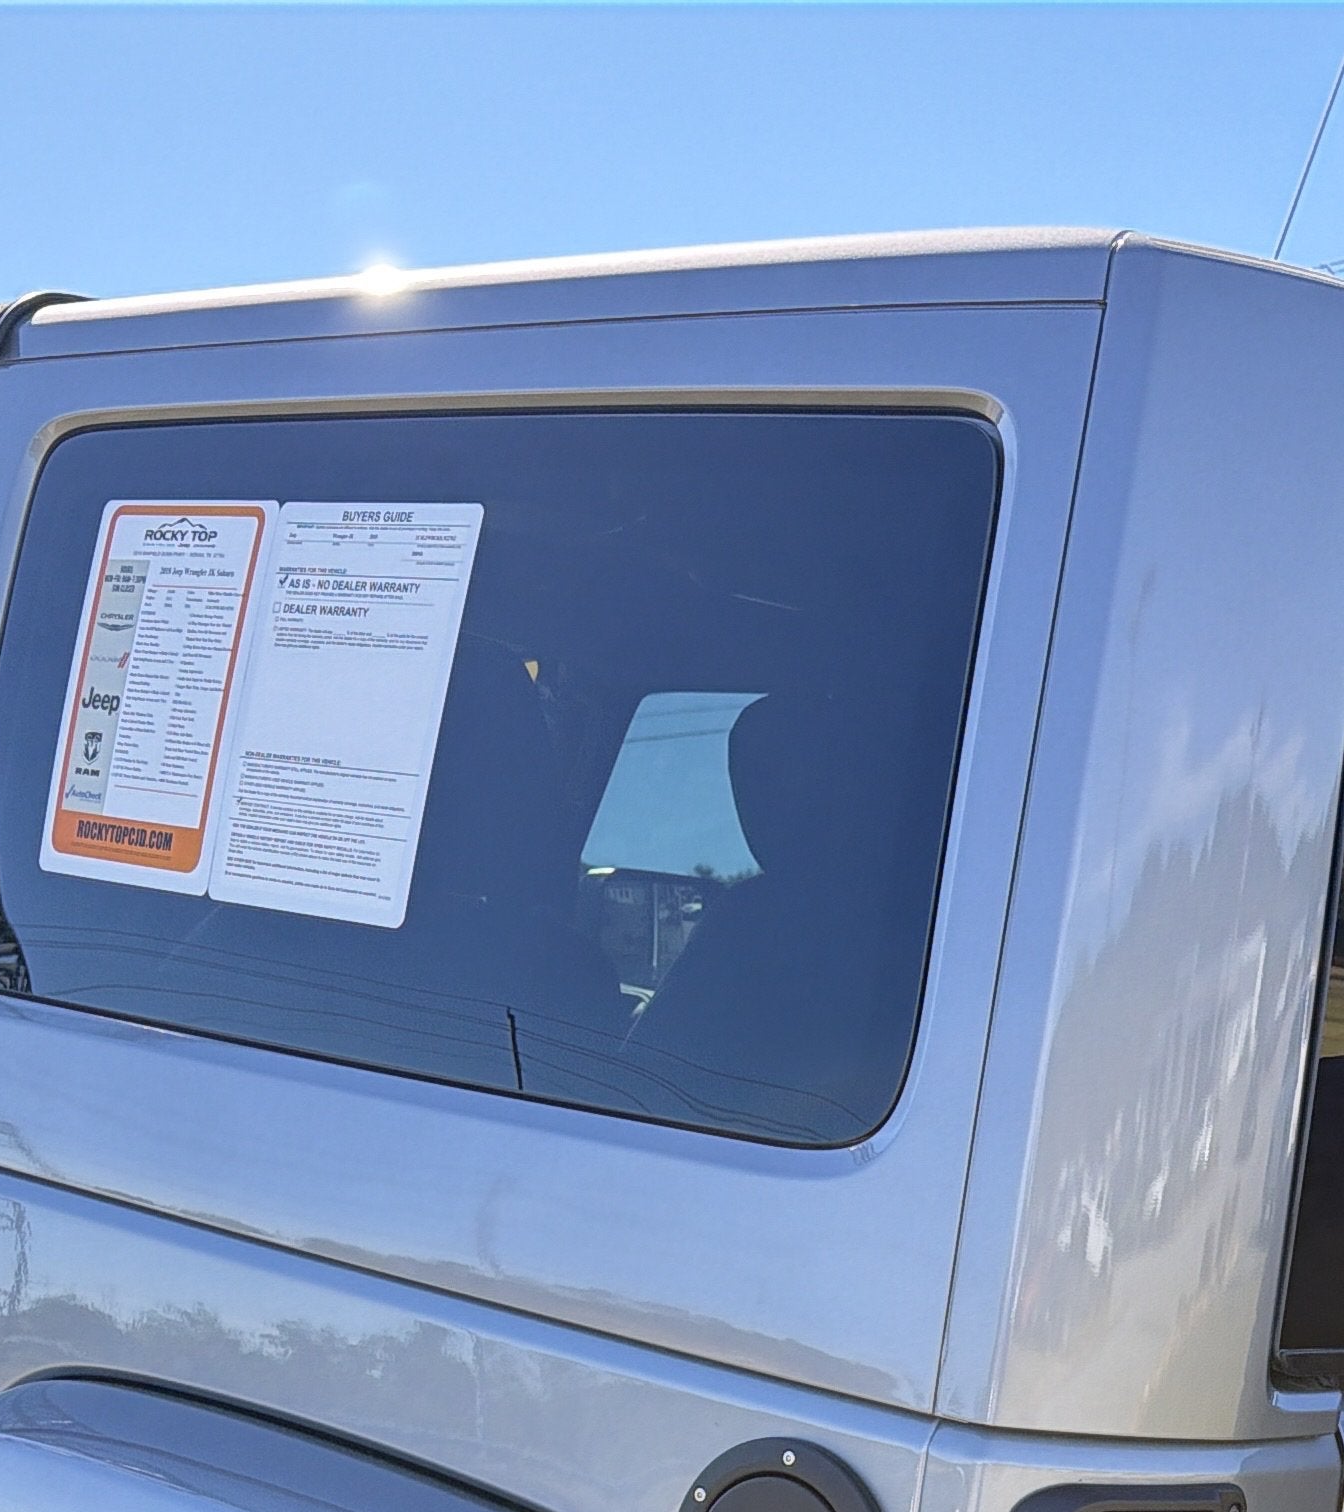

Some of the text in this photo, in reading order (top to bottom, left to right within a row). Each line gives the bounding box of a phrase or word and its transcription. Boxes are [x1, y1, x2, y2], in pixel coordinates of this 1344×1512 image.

[342, 511, 414, 522] BUYERS GUIDE
[144, 529, 217, 542] ROCKY TOP
[172, 567, 183, 577] Jeep
[185, 567, 207, 578] Wrangler
[288, 579, 300, 588] AS
[302, 579, 311, 588] IS
[317, 580, 330, 590] NO
[332, 580, 366, 591] DEALER
[369, 582, 420, 594] WARRANTY
[100, 613, 134, 621] CHRYSLER
[283, 604, 369, 618] DEALER WARRANTY
[82, 686, 120, 716] Jeep
[75, 767, 100, 777] RAM
[76, 819, 174, 852] ROCKYTOPCJD.COM
